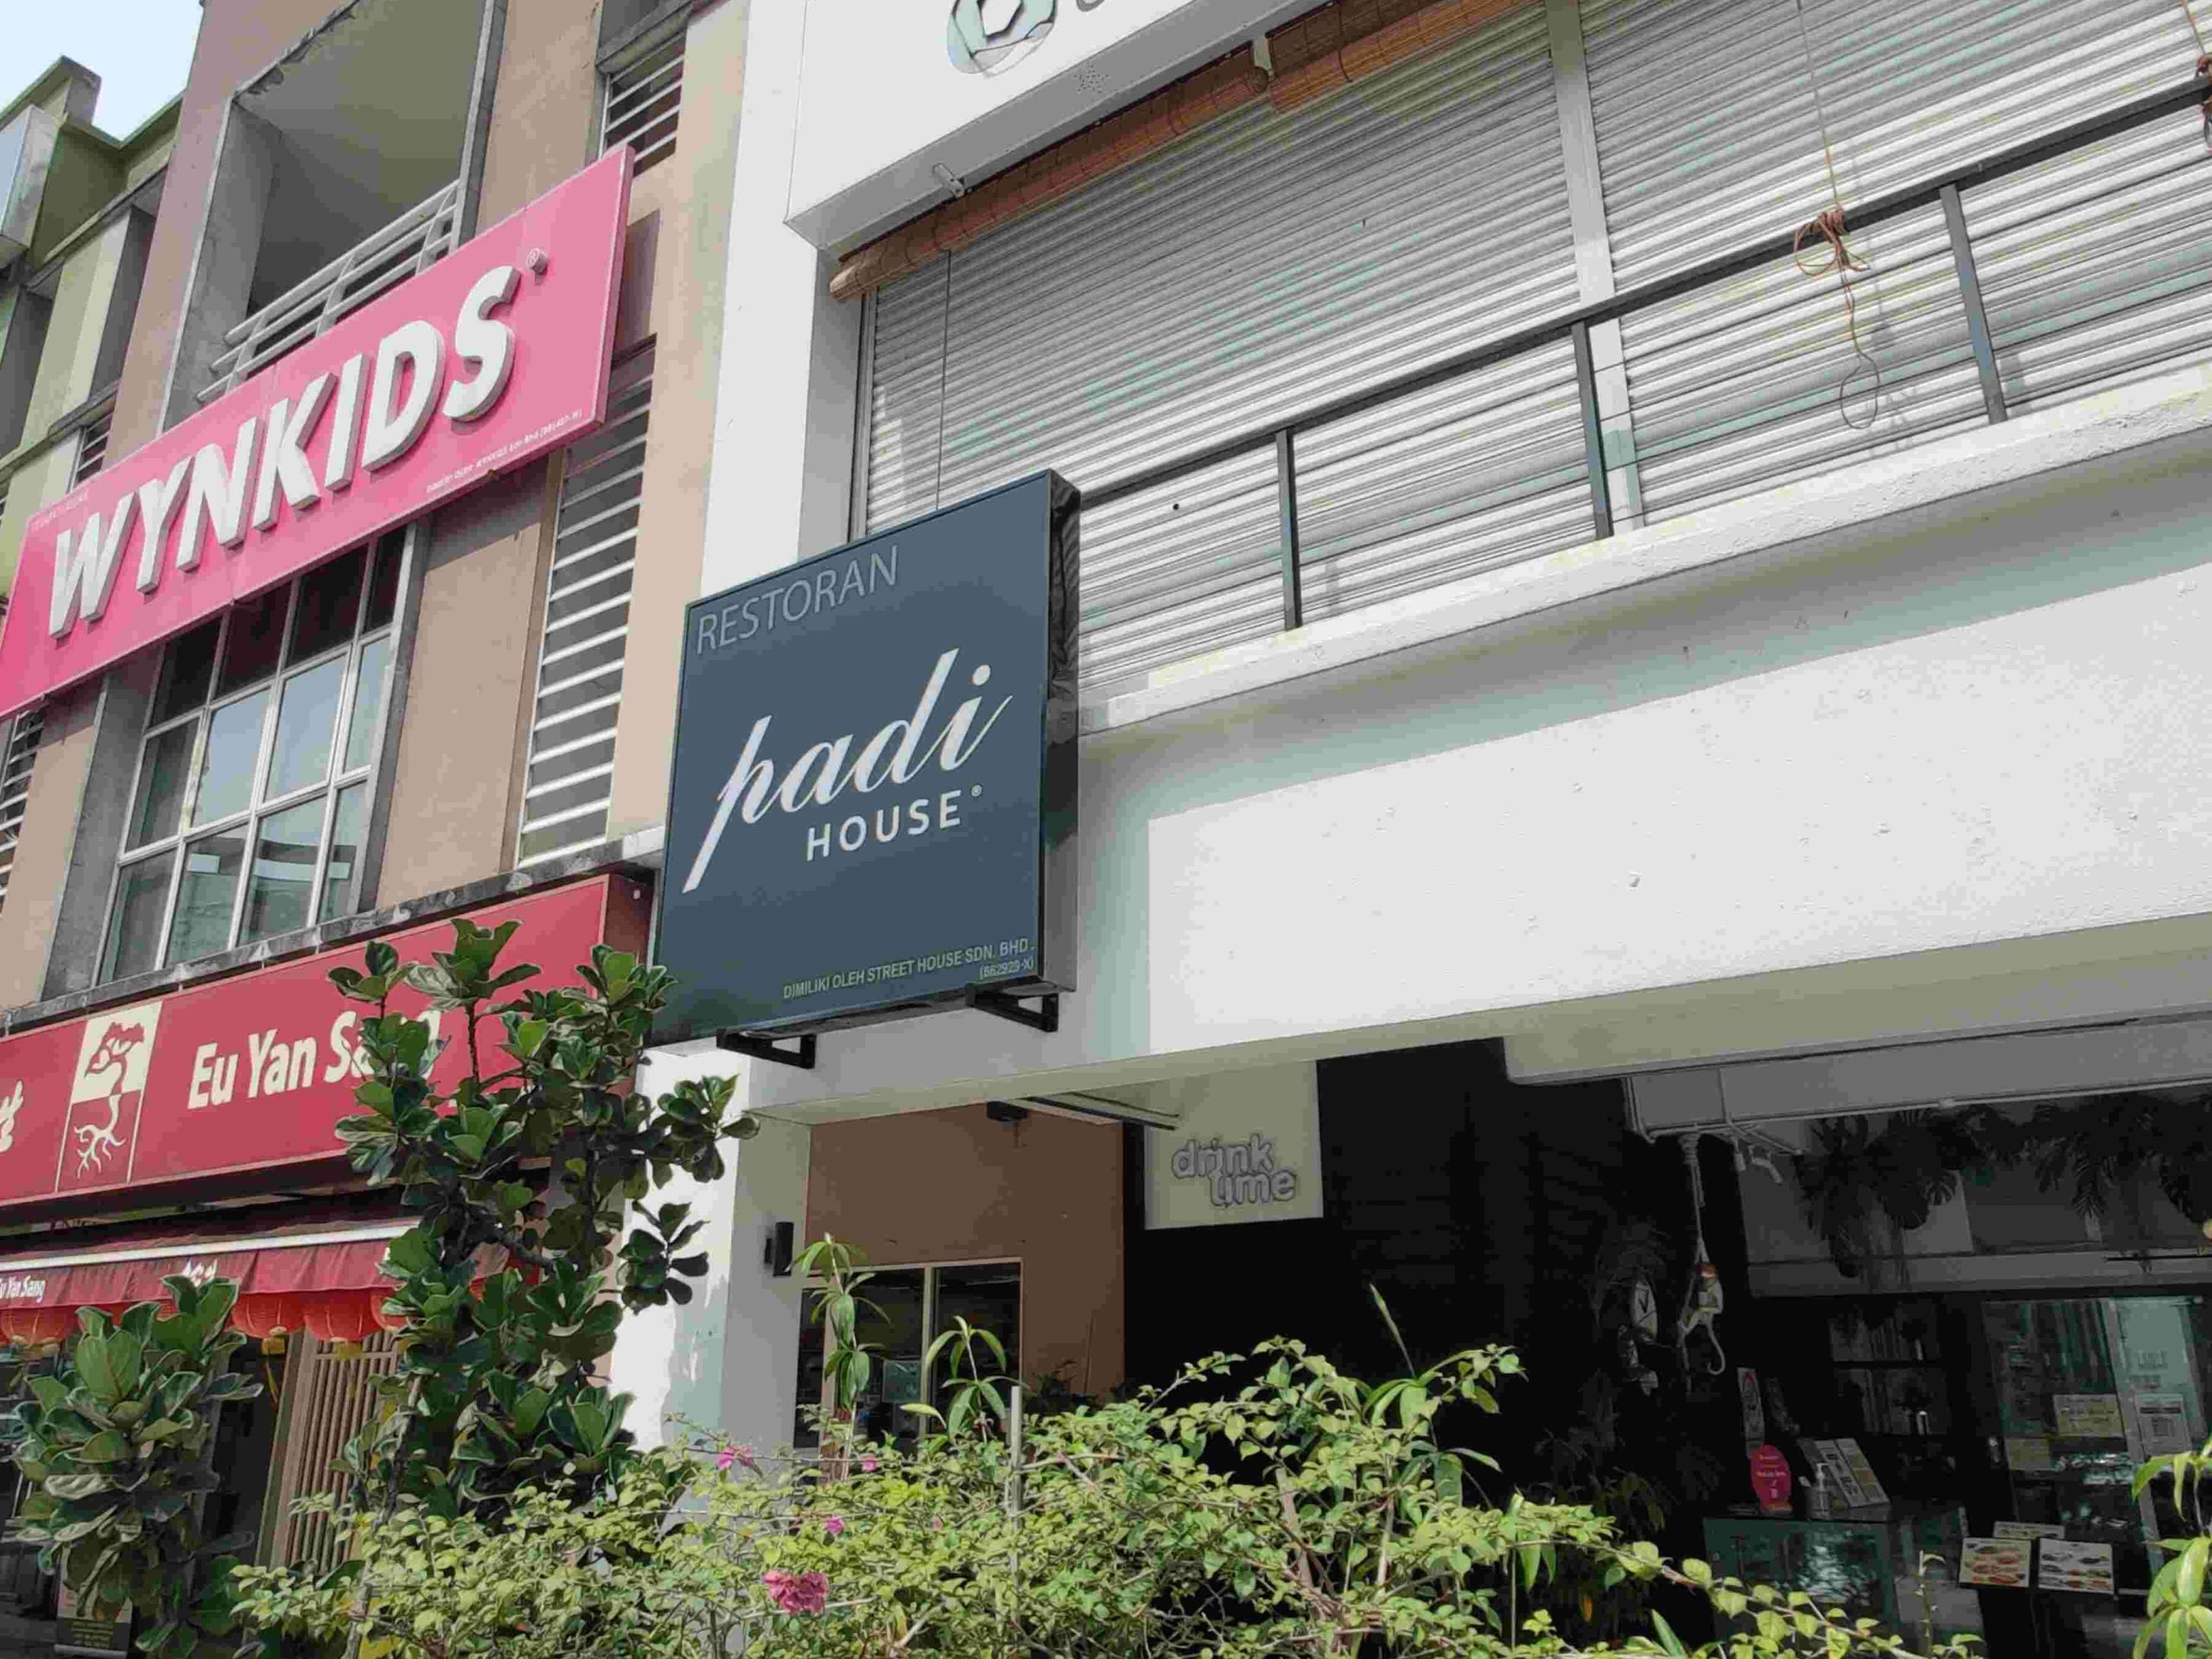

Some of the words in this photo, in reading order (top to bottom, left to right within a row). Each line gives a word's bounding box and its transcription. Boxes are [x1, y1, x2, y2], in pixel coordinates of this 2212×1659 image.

[48, 264, 525, 641] WYNKIDS
[696, 545, 899, 655] RESTORAN
[683, 646, 1014, 893] padi
[805, 789, 962, 862] HOUSE
[783, 977, 830, 1000] DIMILIKI
[832, 970, 865, 990] OLEH
[867, 959, 916, 982] STREET
[917, 950, 963, 974] HOUSE
[964, 944, 995, 963] SDN.
[187, 1042, 238, 1110] Eu
[247, 1030, 317, 1099] Yan
[1172, 1134, 1273, 1179] drink
